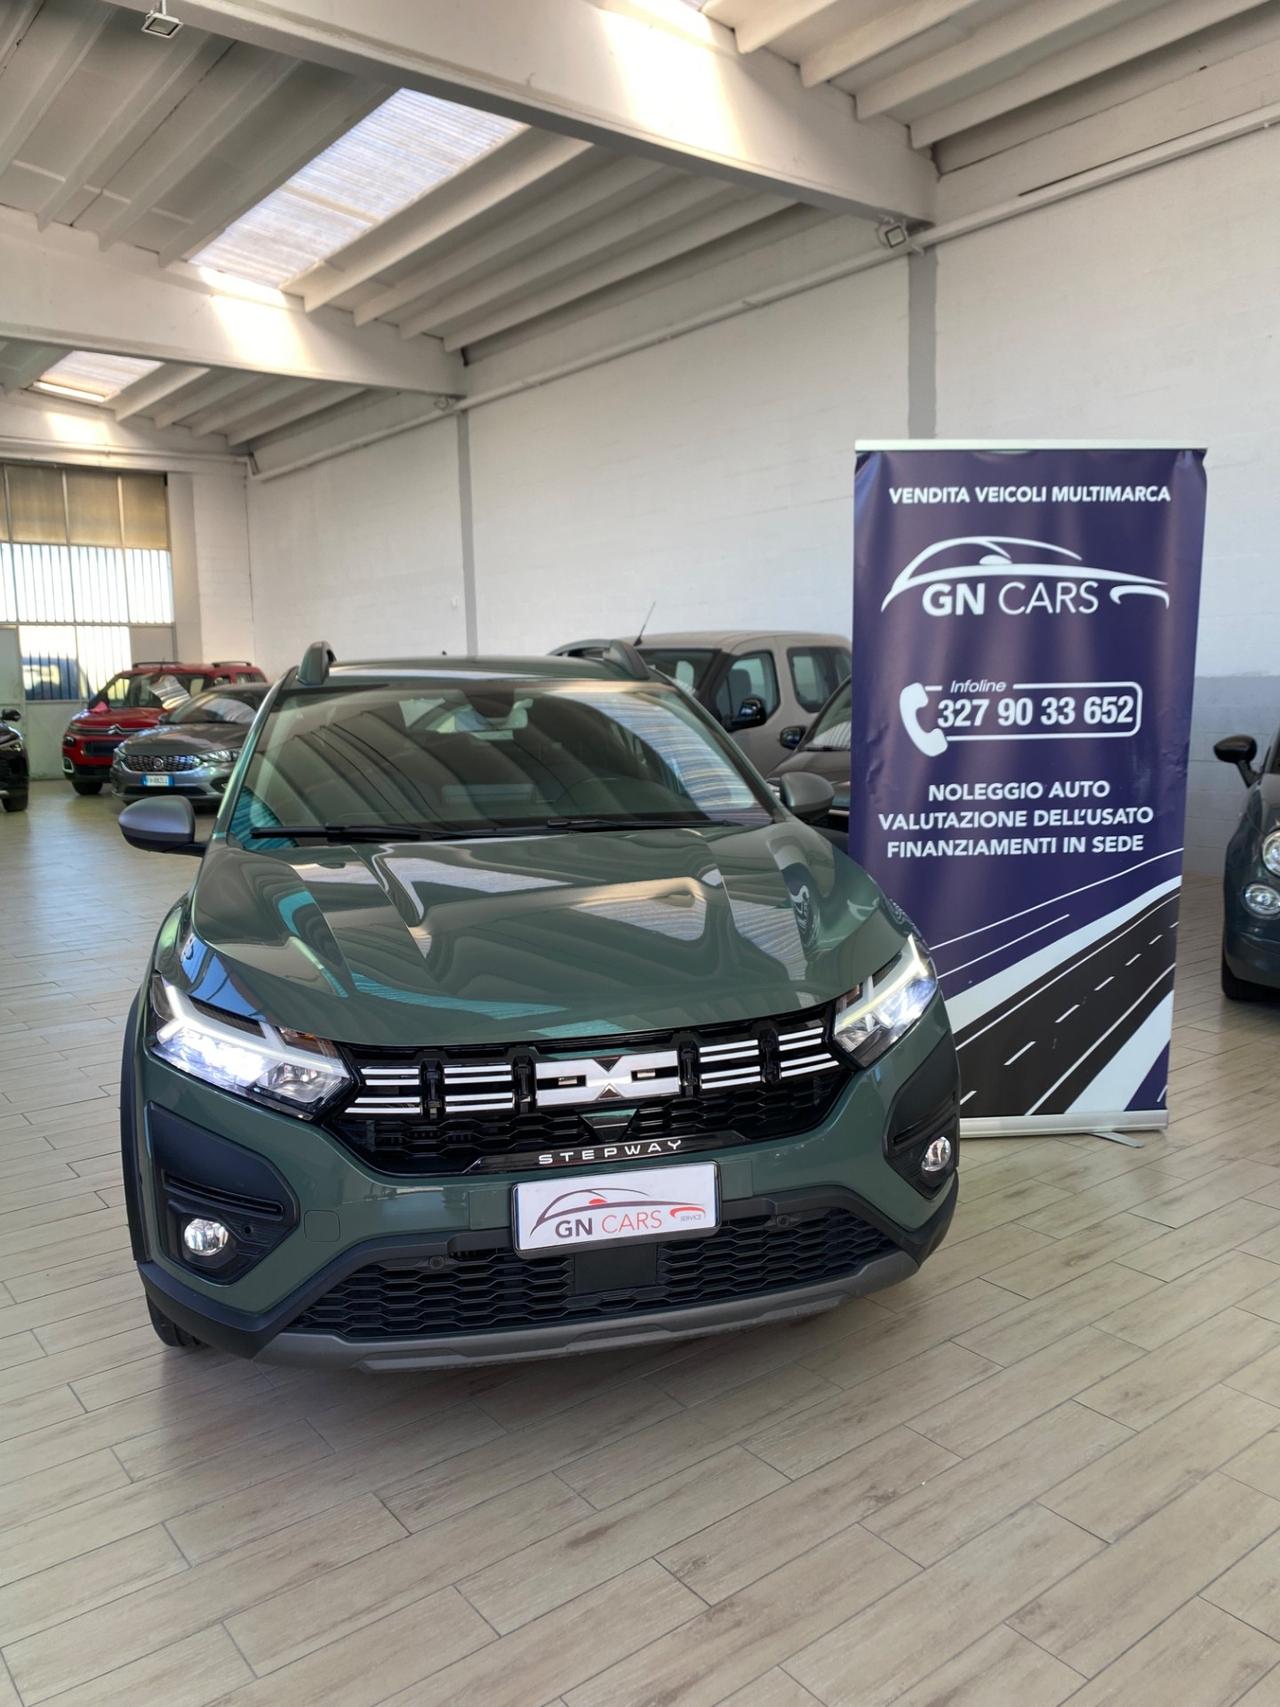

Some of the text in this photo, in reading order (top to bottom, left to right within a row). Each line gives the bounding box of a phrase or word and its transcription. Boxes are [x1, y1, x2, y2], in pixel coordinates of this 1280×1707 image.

[889, 486, 1171, 504] VENDITA VEICOLI MULTIMARCA
[922, 581, 1099, 617] GN CARS
[950, 679, 1006, 693] Infoline
[937, 696, 1134, 728] 327 90 33 652
[928, 780, 1110, 802] NOLEGGIO AUTO
[878, 806, 1154, 831] VALUTAZIONE DELL'USATO
[887, 834, 1144, 858] FINANZIAMENTI IN SEDE
[538, 1139, 682, 1165] STEPWAY
[555, 1217, 593, 1238] GN
[601, 1210, 663, 1234] CARS
